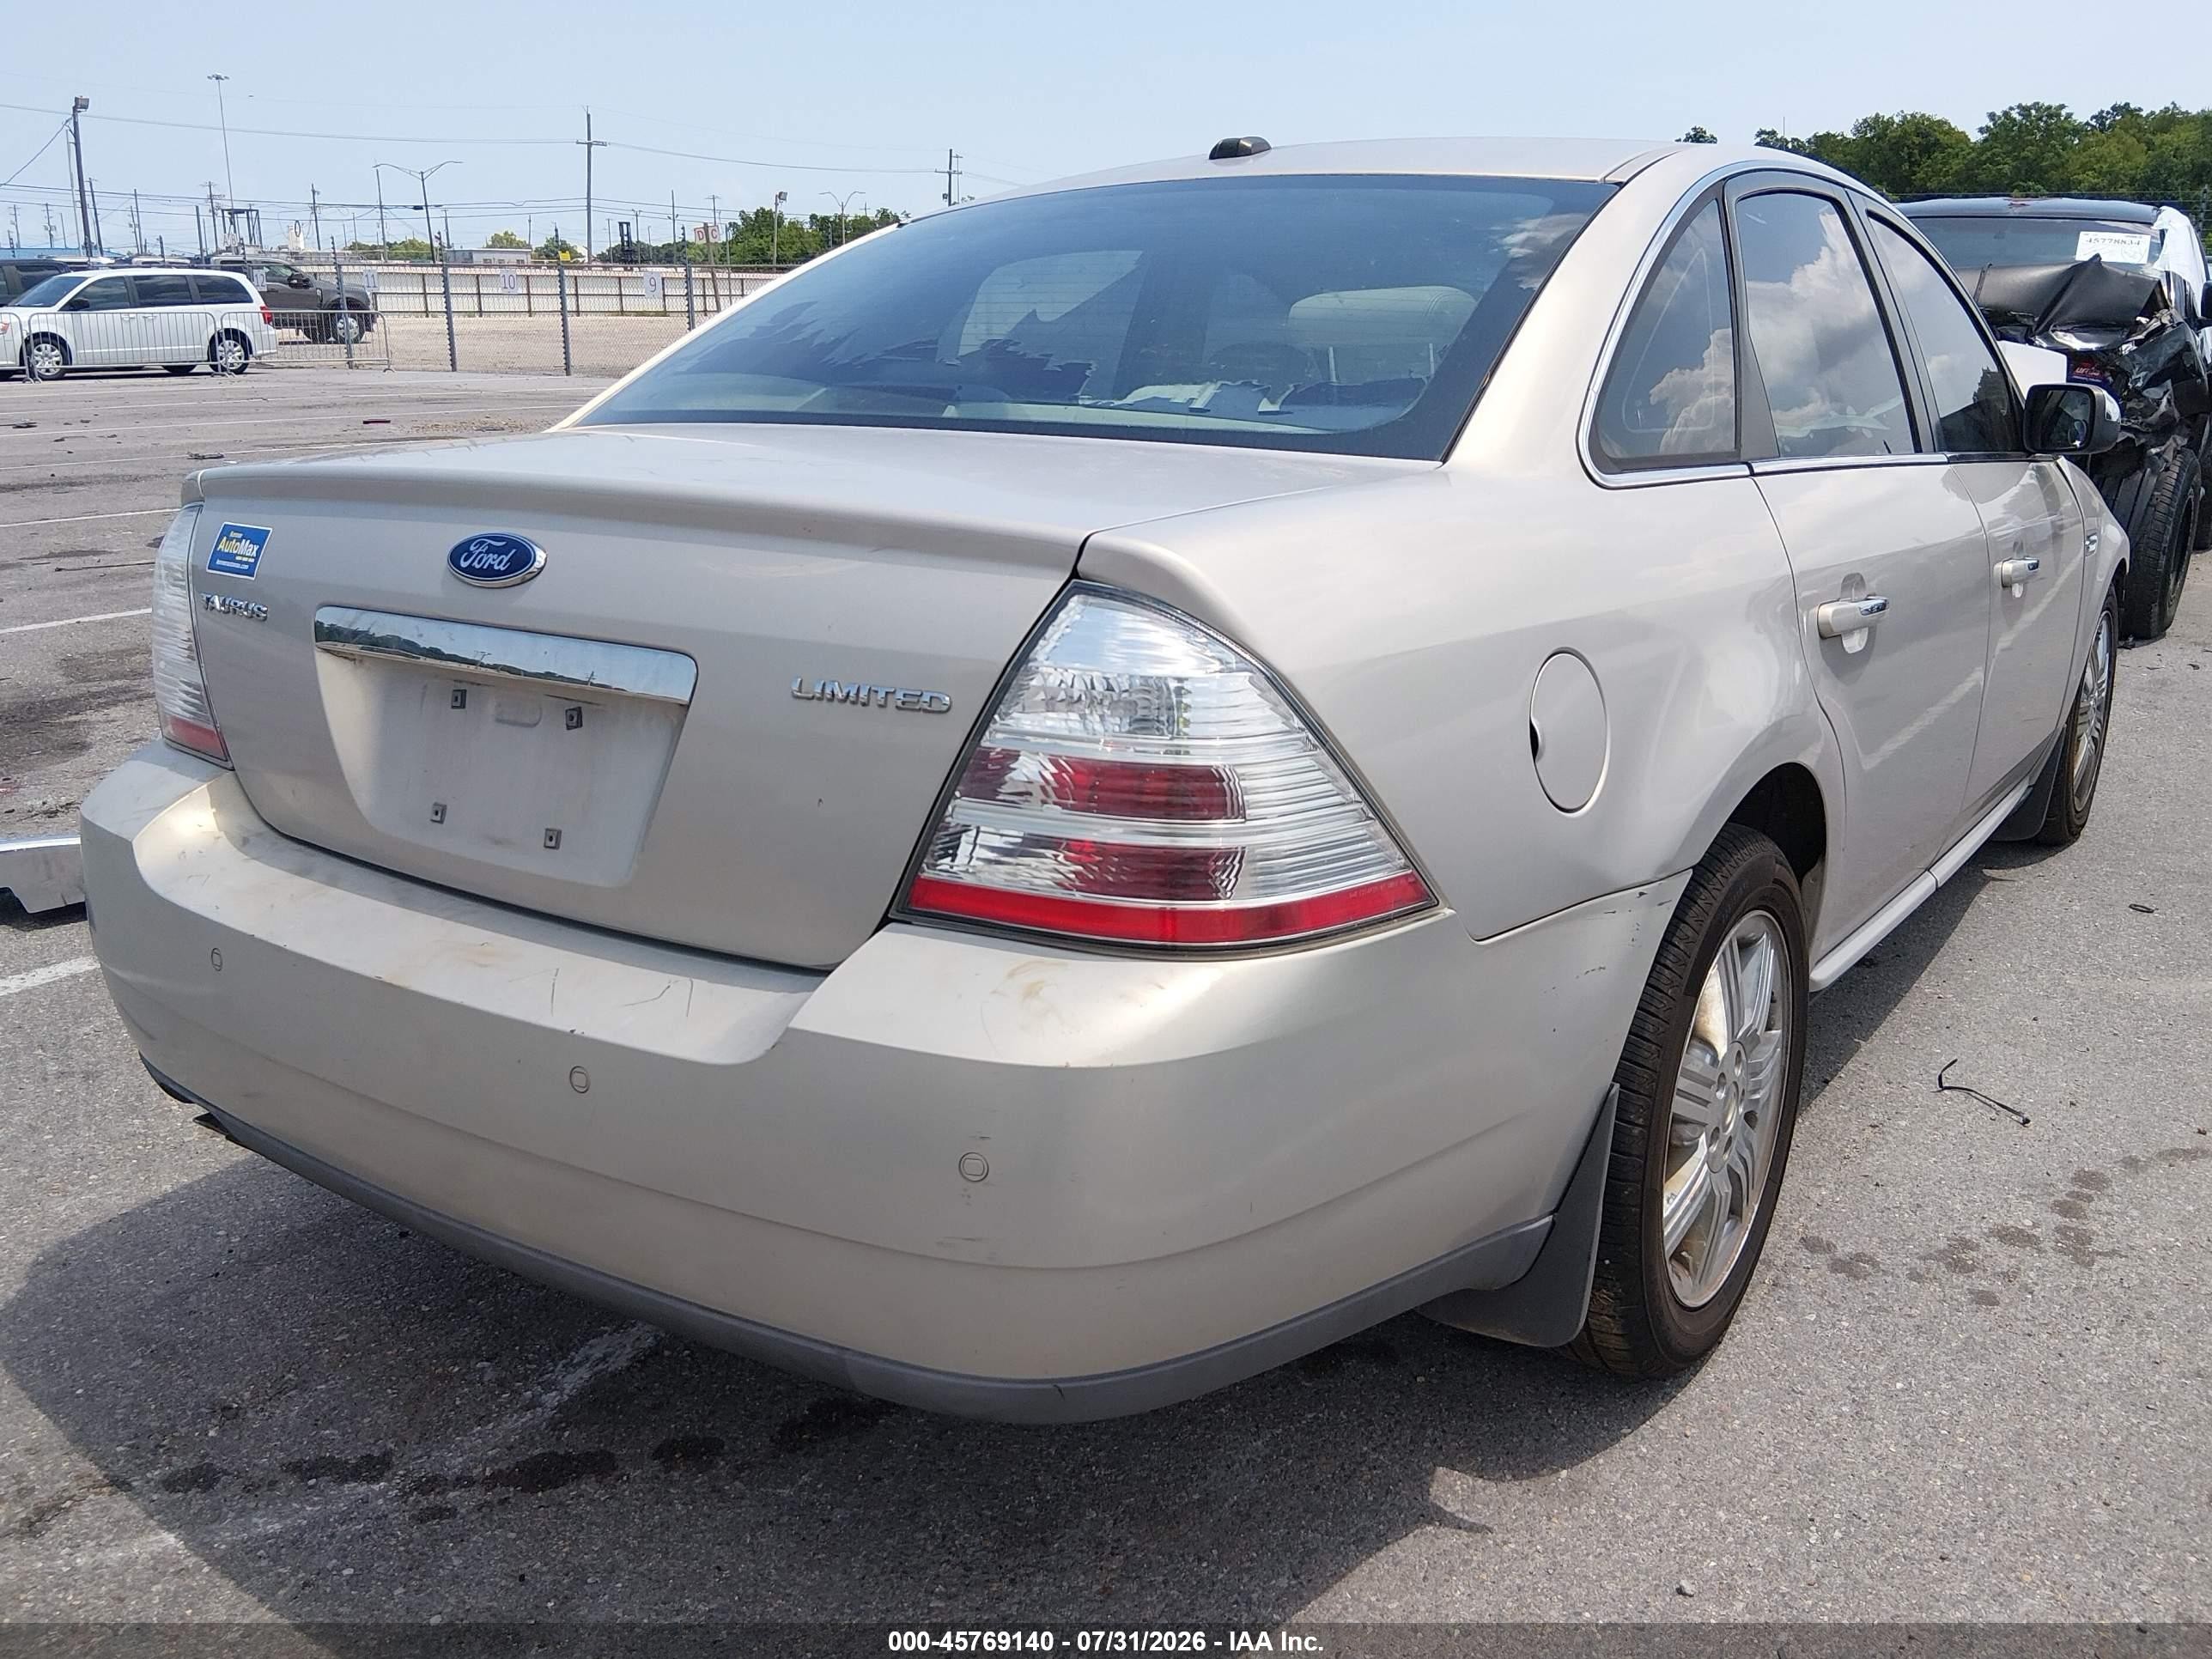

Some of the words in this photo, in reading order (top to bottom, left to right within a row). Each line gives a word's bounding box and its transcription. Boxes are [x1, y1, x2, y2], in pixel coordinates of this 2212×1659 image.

[696, 229, 704, 241] D
[711, 228, 718, 240] C
[364, 274, 378, 289] 11
[501, 274, 515, 290] 10
[648, 276, 657, 293] 9
[216, 536, 259, 557] AutoMax
[459, 538, 517, 571] Ford
[199, 592, 268, 622] TAURUS
[791, 677, 952, 714] LIMITED
